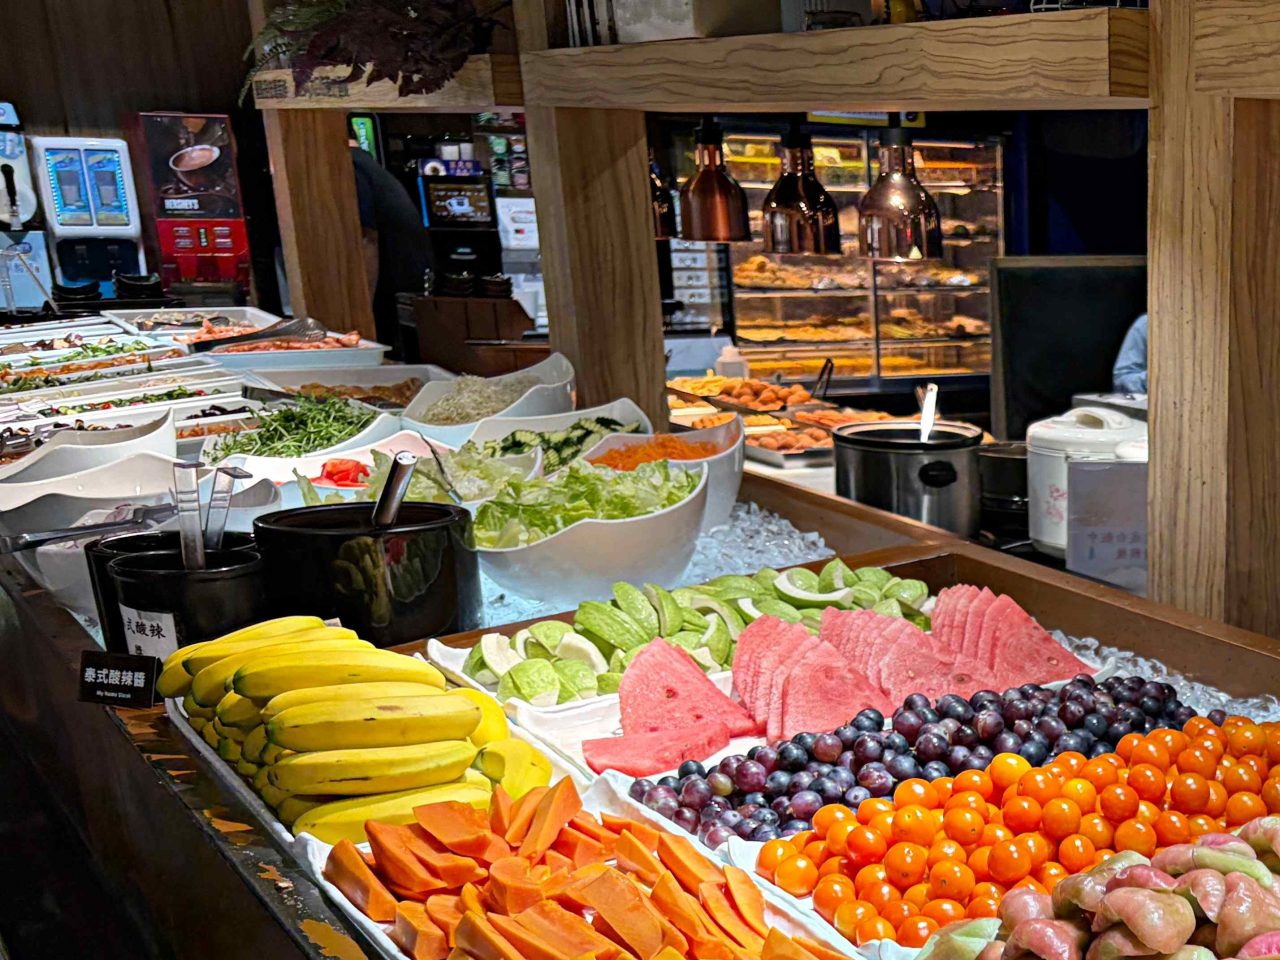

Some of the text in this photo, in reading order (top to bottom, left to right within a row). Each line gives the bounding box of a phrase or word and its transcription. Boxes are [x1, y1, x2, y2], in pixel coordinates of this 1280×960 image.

[84, 667, 146, 688] 泰式酸辣醬
